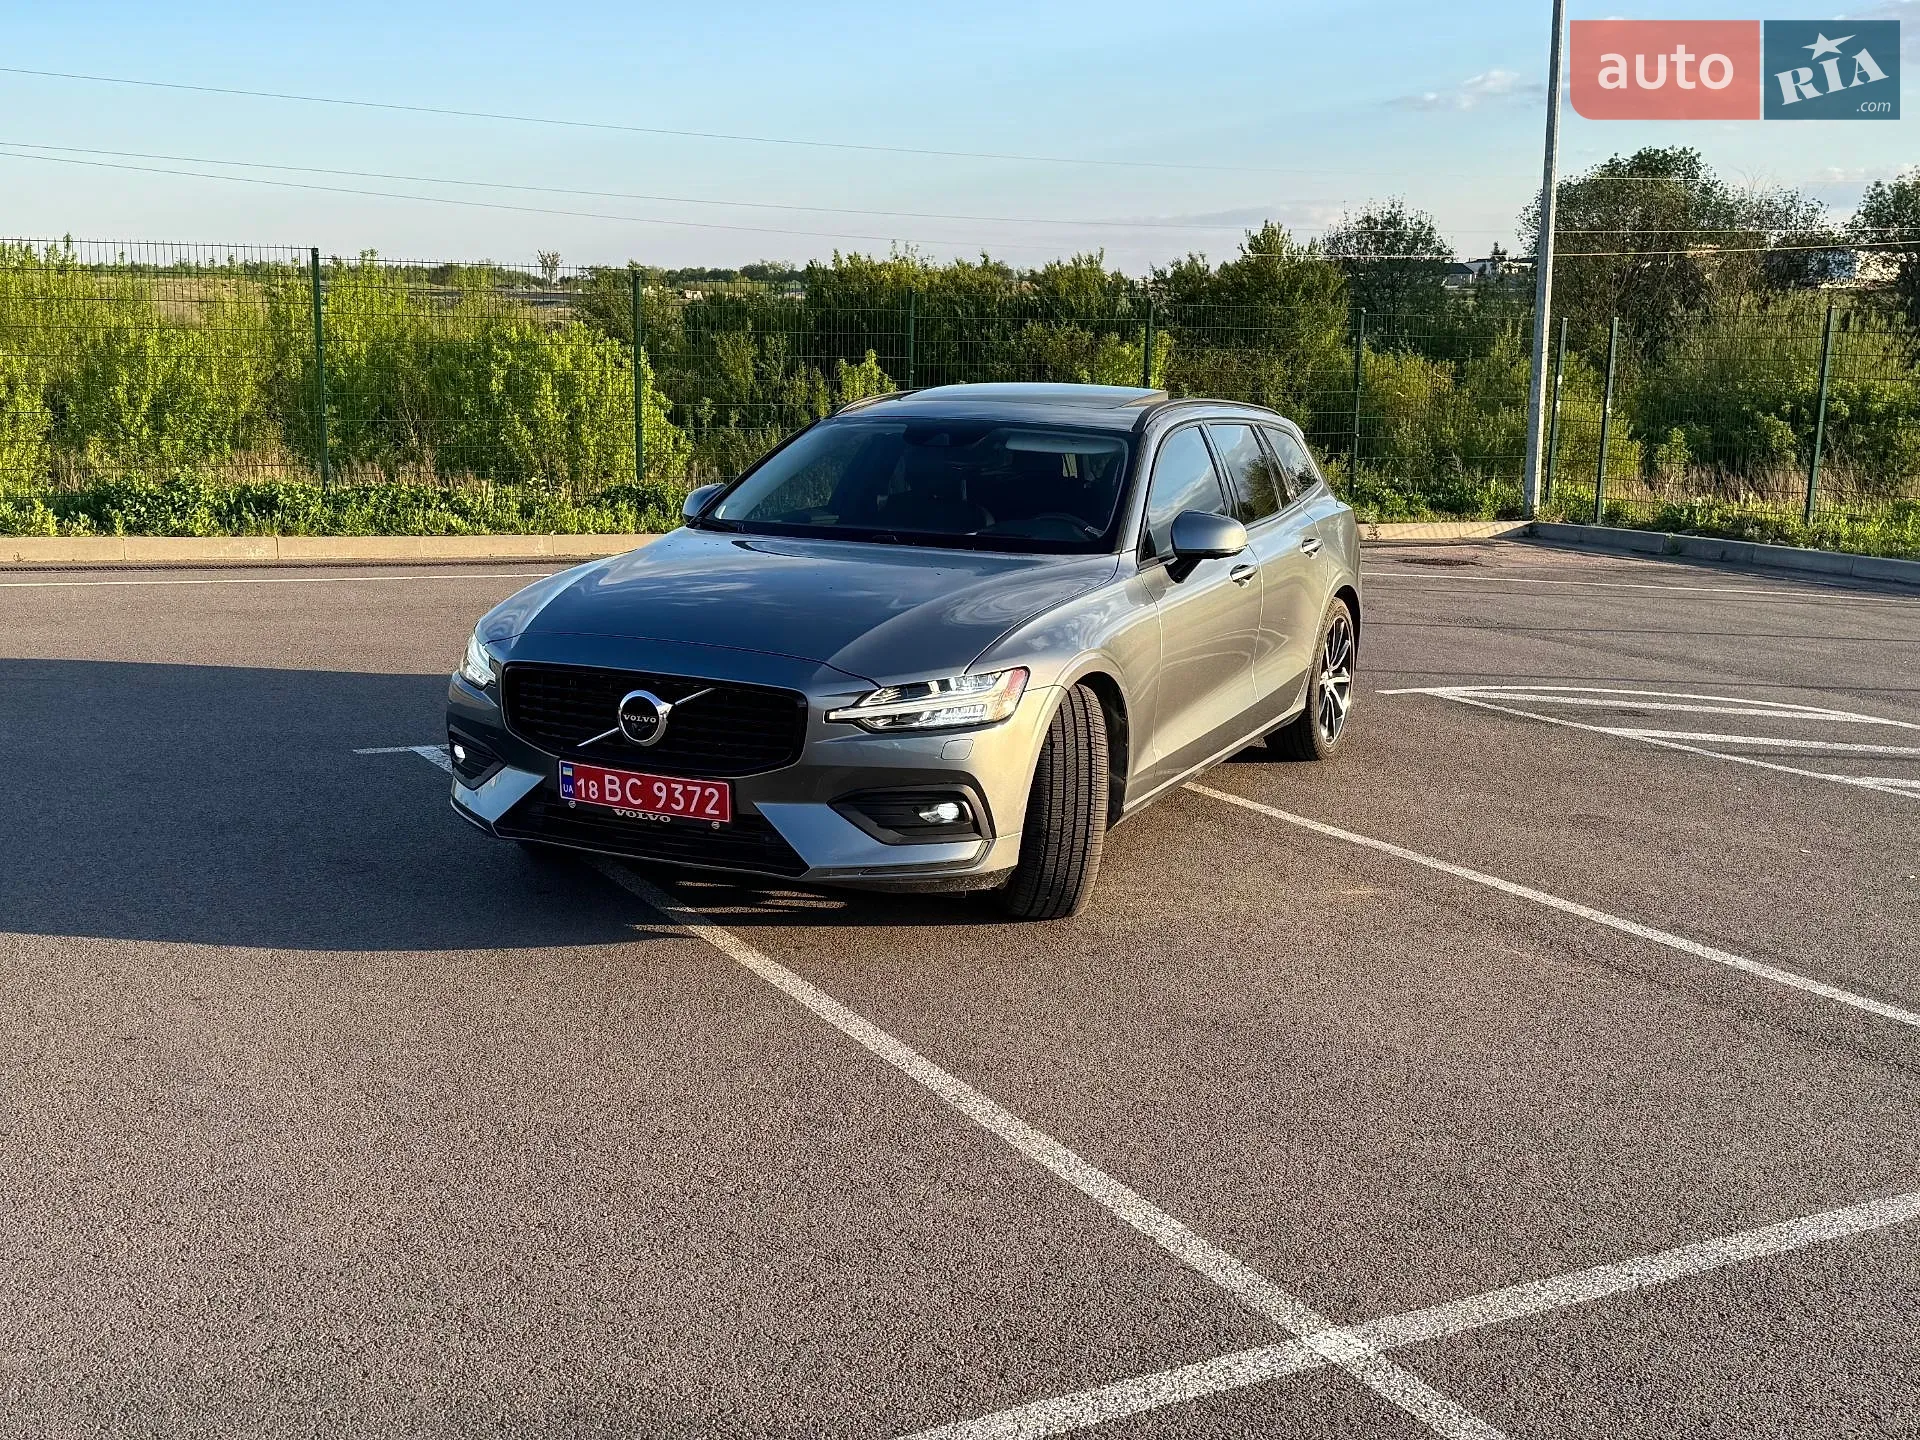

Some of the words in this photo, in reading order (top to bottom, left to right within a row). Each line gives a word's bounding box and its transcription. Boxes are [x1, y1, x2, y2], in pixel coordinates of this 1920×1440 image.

[623, 714, 657, 723] VOLVO
[563, 784, 574, 793] UA
[576, 778, 599, 800] 18
[604, 775, 643, 805] BC
[653, 782, 720, 815] 9372
[612, 808, 671, 823] VOLVO
